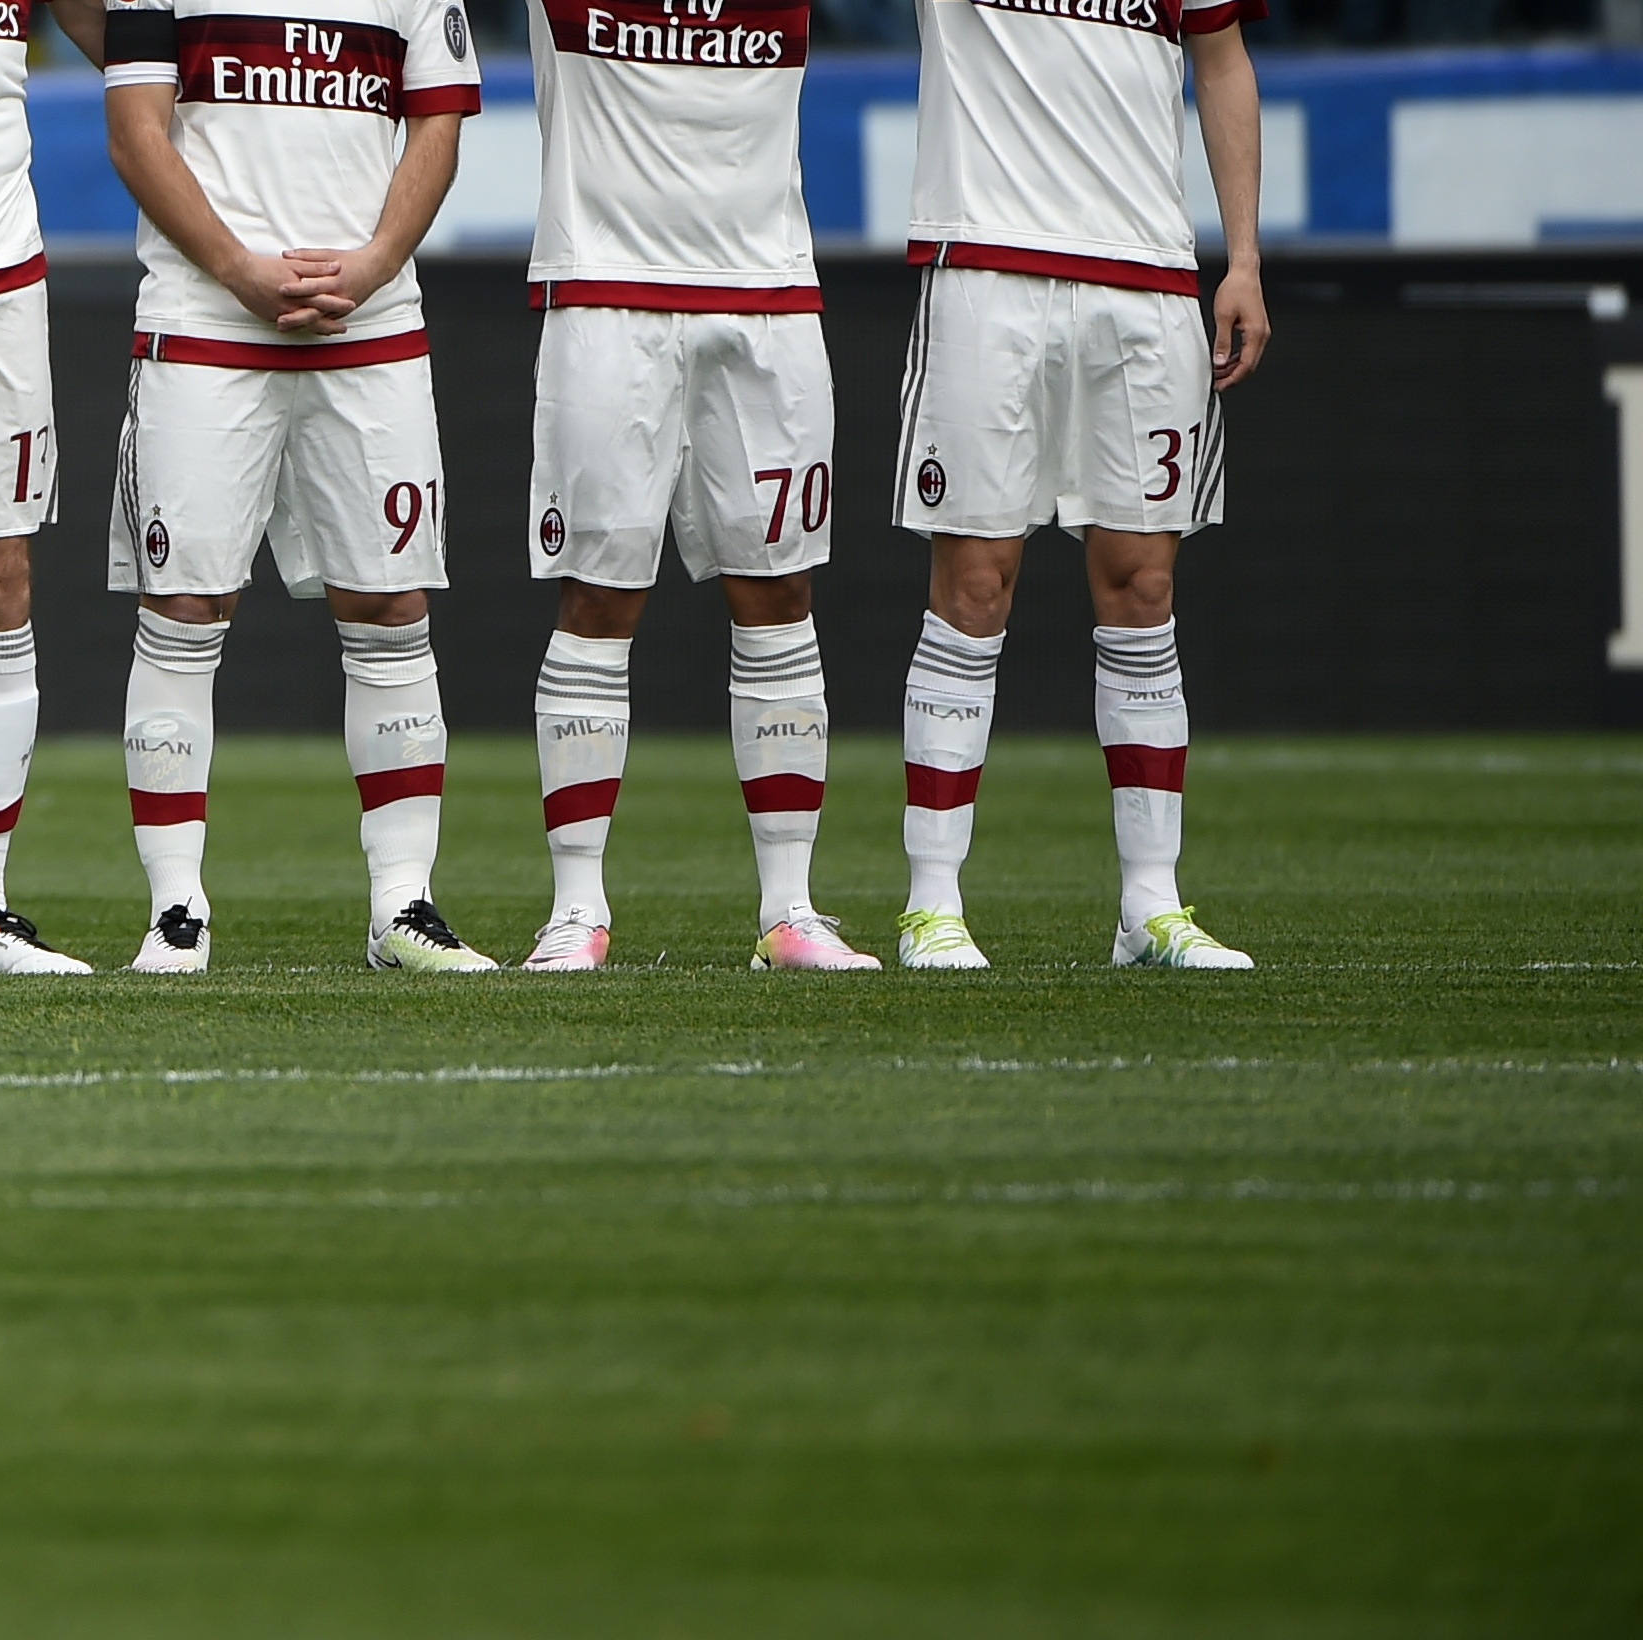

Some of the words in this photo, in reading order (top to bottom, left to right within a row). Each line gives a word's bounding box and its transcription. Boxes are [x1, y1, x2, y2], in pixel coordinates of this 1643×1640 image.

[284, 22, 343, 63] Fly
[587, 7, 784, 65] Emirates
[384, 478, 438, 555] 91
[754, 461, 830, 545] 70
[1126, 686, 1182, 701] MILA
[906, 694, 981, 722] MILAN
[376, 714, 442, 736] MILA
[553, 719, 626, 740] MILAN
[123, 738, 192, 756] MILAN
